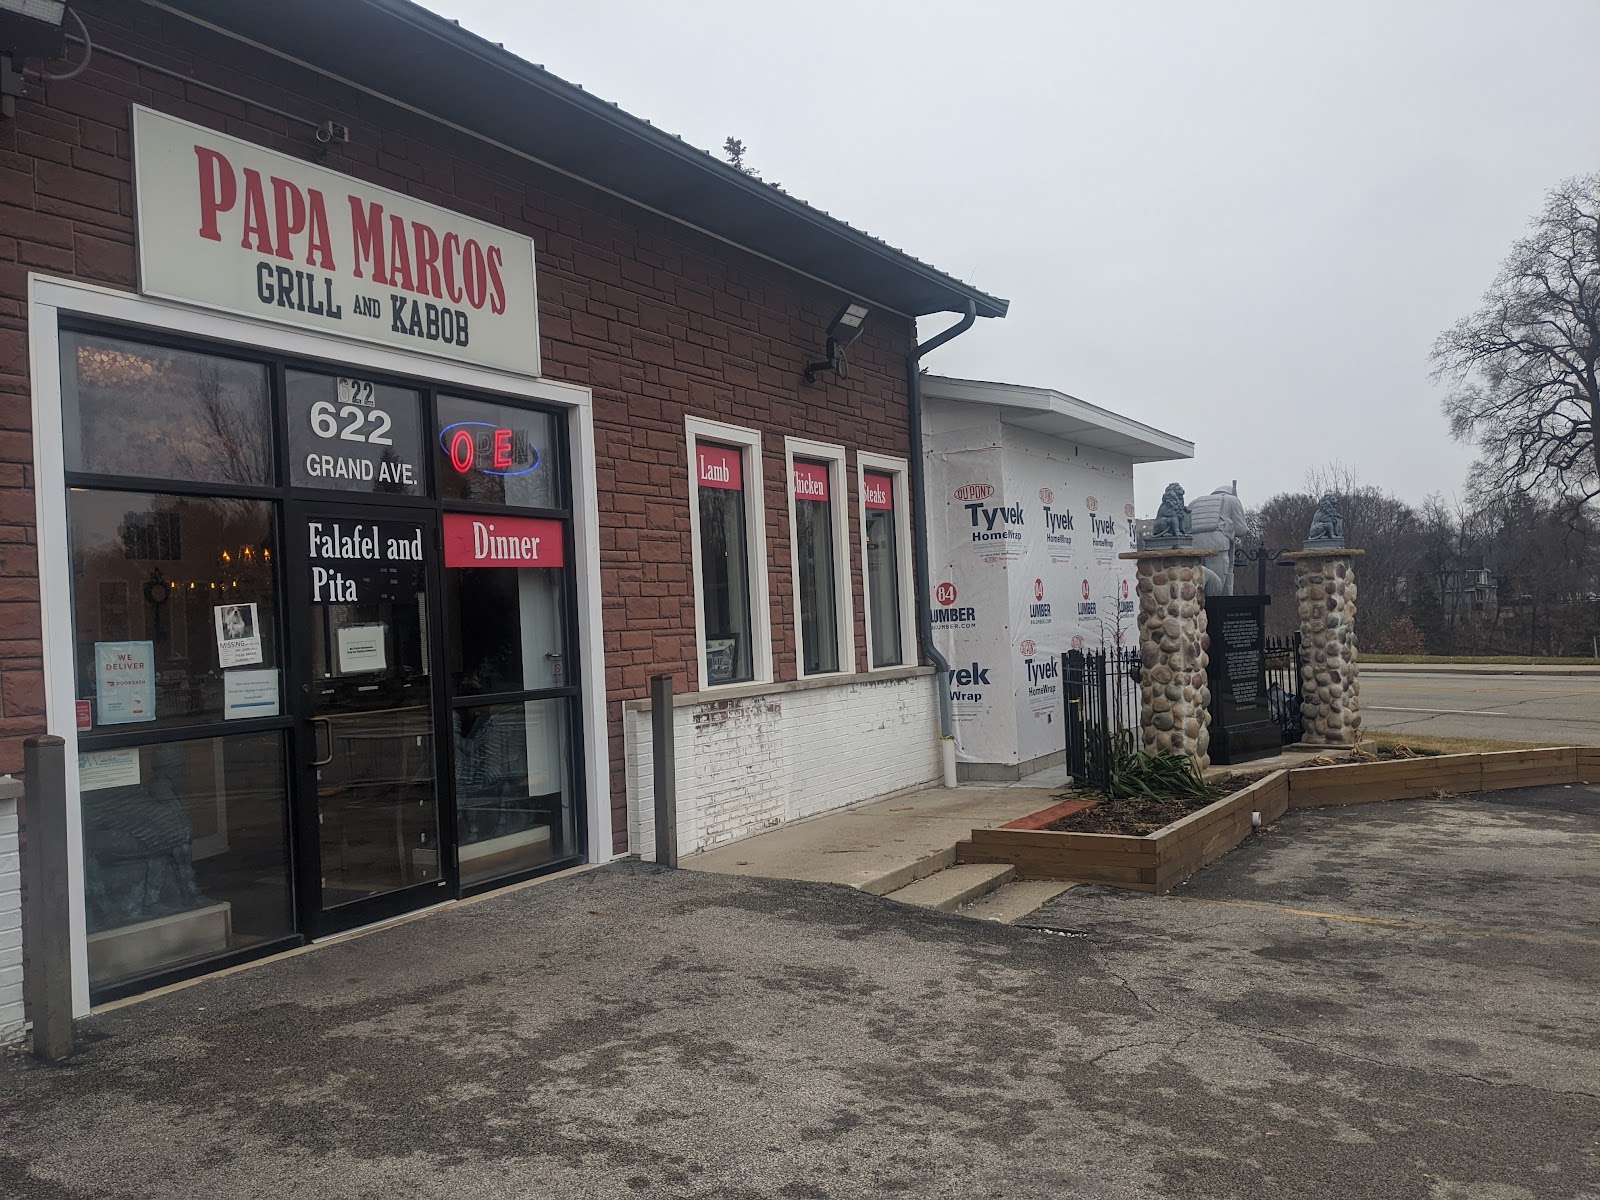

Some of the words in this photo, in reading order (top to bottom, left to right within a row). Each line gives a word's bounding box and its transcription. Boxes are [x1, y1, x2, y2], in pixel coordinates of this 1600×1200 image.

[194, 145, 335, 271] PAPA
[348, 194, 506, 315] MARCOS
[257, 261, 341, 319] GRILL
[353, 295, 381, 319] AND
[391, 294, 469, 347] KABOB
[339, 378, 374, 405] 622
[310, 401, 393, 446] 622
[450, 429, 528, 473] OPEN
[306, 453, 374, 481] GRAND
[379, 461, 418, 485] AVE.
[700, 454, 729, 483] Lamb
[964, 502, 1024, 531] Tyvek
[1042, 506, 1074, 534] Tyvek
[1089, 513, 1115, 538] Tyvek
[308, 522, 380, 560] Falafel
[387, 529, 423, 561] and
[473, 521, 540, 560] Dinner
[972, 529, 1022, 542] HomeWrap
[312, 567, 358, 602] Pita
[938, 586, 955, 602] 84
[1035, 582, 1043, 597] 84
[1030, 603, 1051, 618] LUMBER
[220, 641, 245, 649] MISSING
[106, 662, 145, 670] DELIVER
[949, 662, 991, 686] vek
[1024, 655, 1058, 686] Tyvek
[950, 691, 982, 703] Wrap
[1028, 684, 1056, 697] HomeWrap
